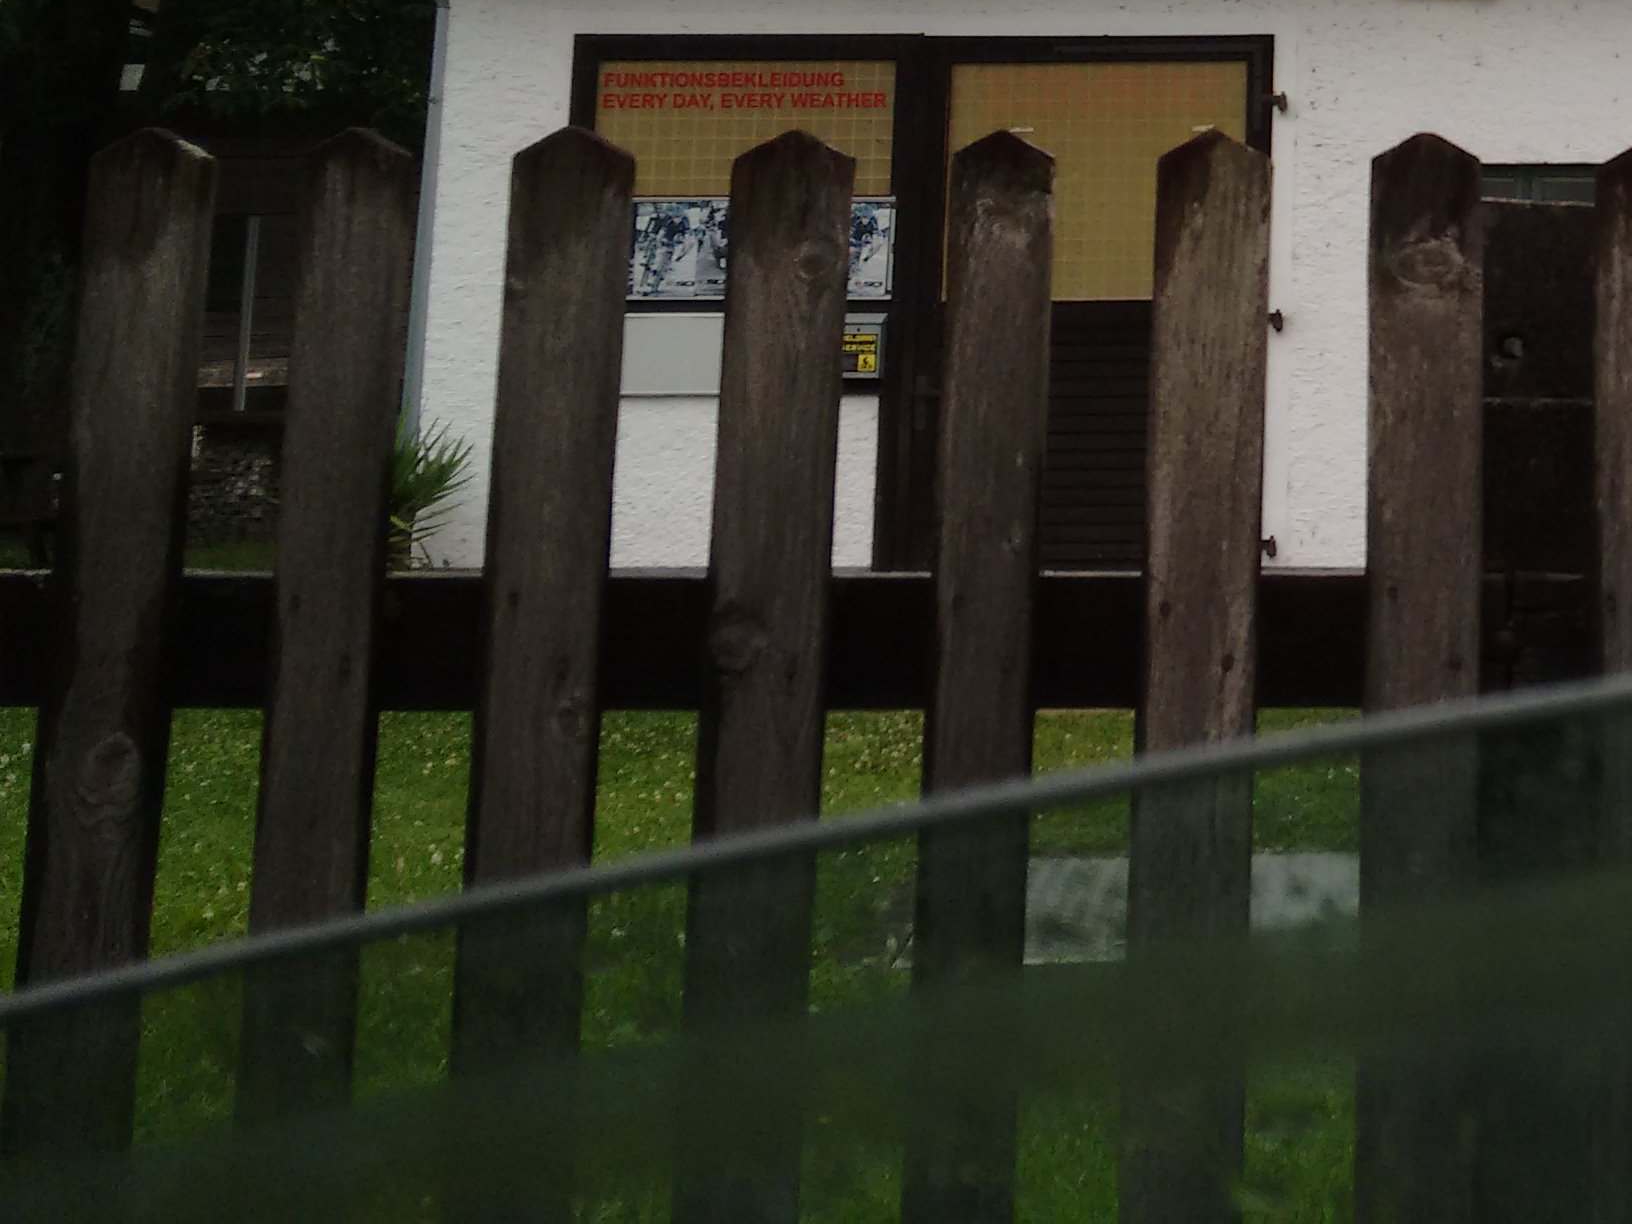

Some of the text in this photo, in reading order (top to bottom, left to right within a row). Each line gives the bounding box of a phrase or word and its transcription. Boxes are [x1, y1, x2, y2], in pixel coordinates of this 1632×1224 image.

[603, 72, 845, 88] FUNKTIONSBEKLEIDUNG
[602, 92, 887, 110] EVERY DAY, EVERY WEATHER
